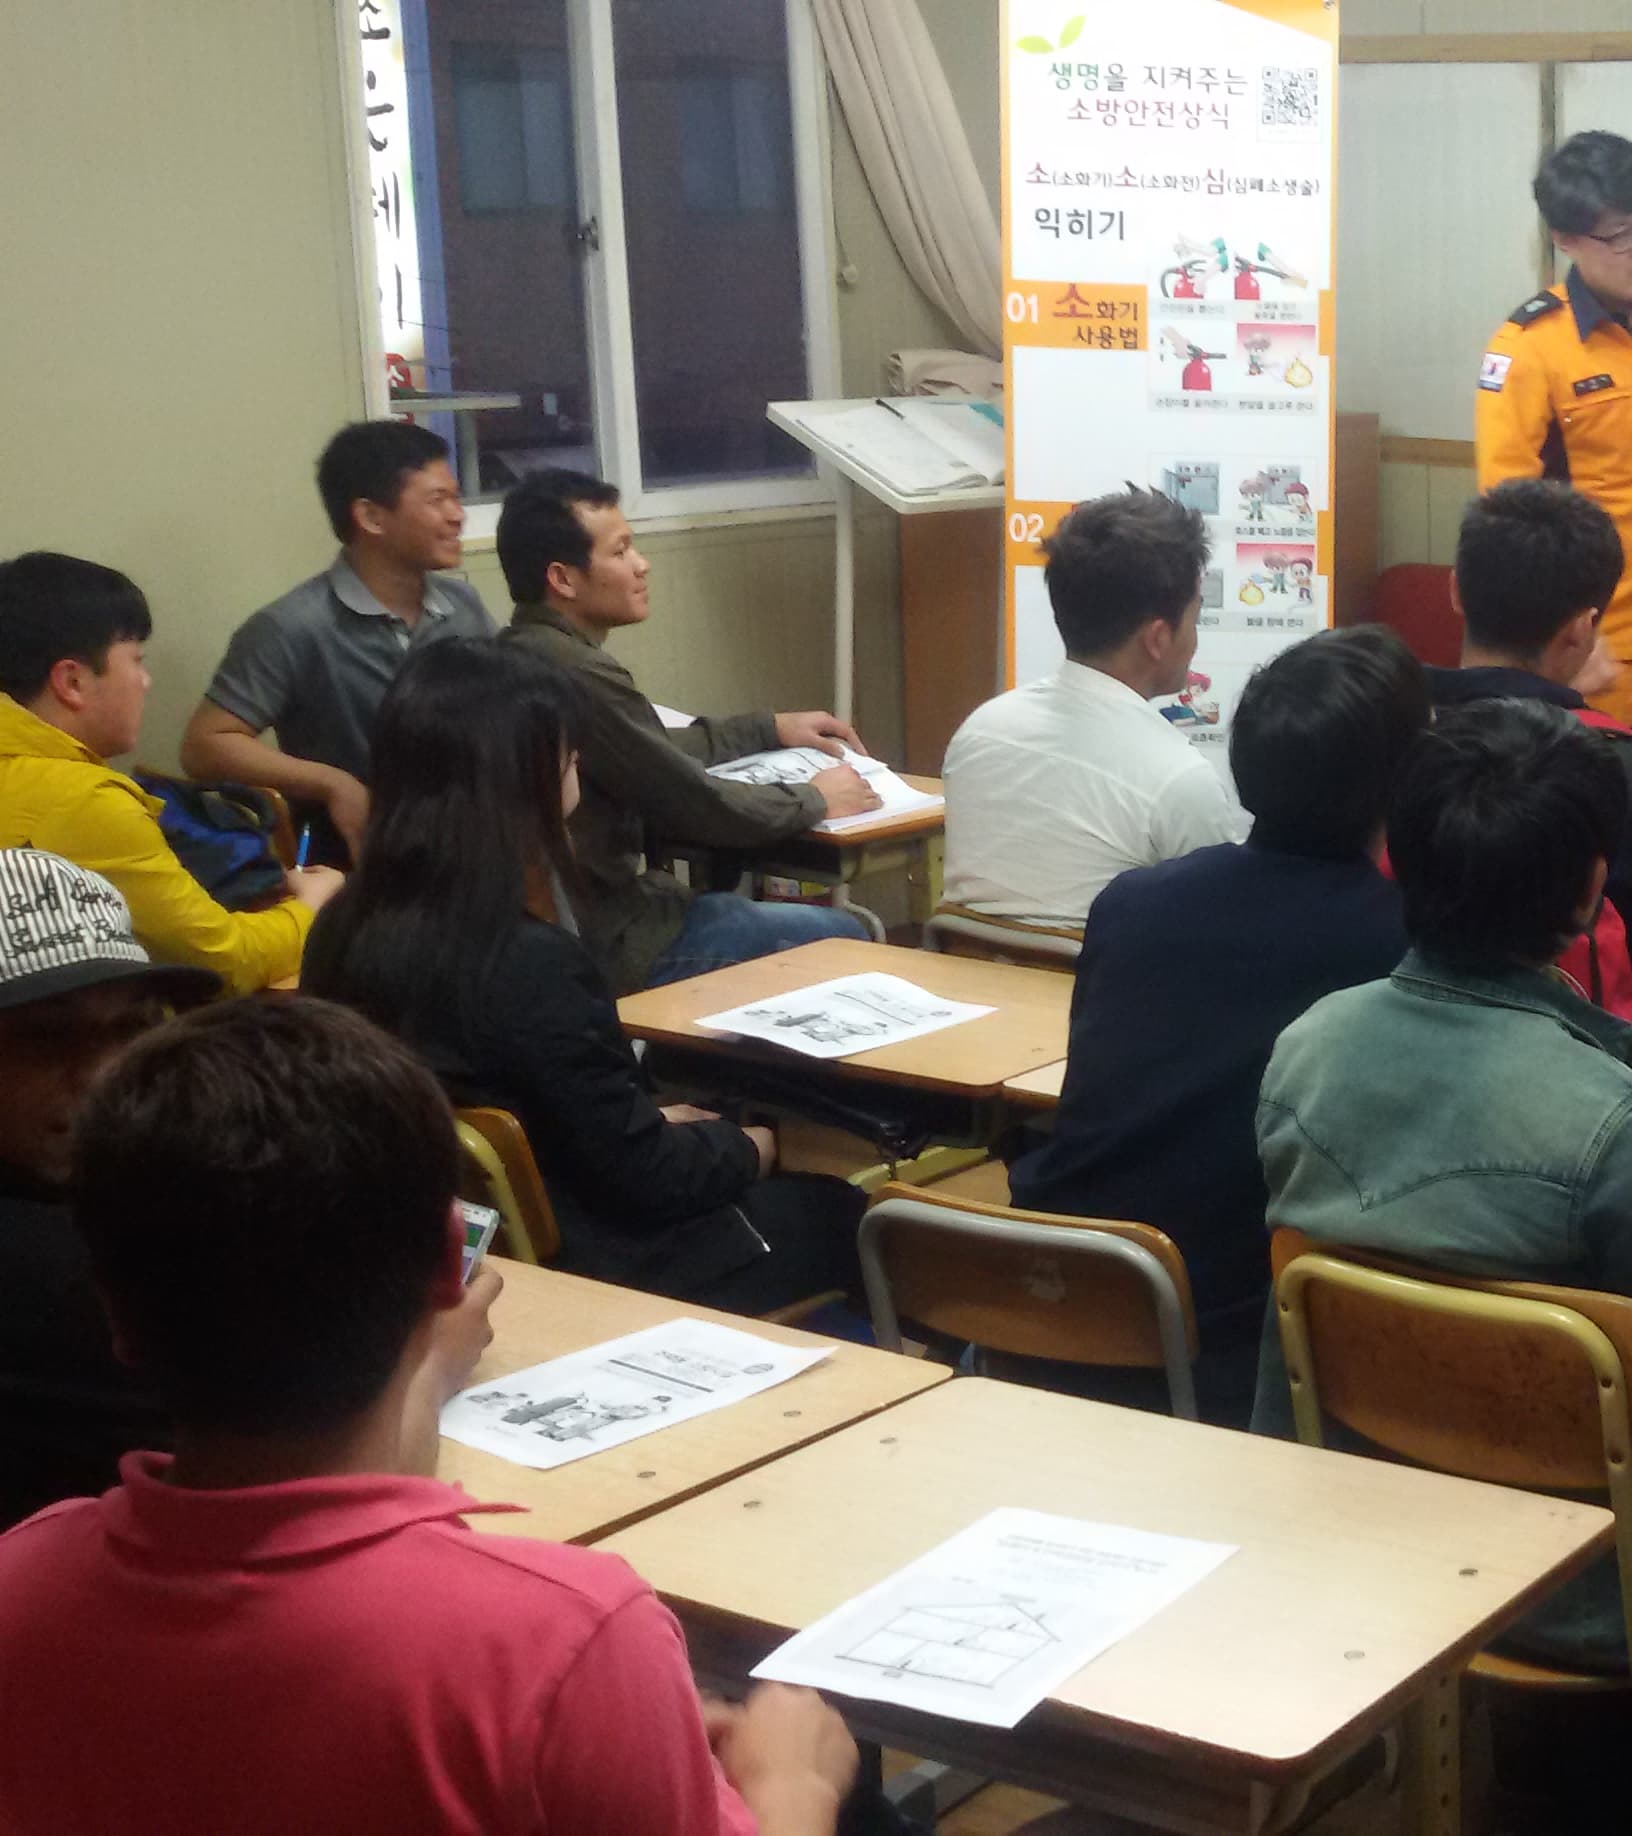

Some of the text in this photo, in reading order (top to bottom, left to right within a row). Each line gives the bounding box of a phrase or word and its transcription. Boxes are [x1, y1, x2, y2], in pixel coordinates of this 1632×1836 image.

[1050, 63, 1248, 95] 생명을 지켜주는
[1067, 98, 1229, 130] 소방안전상식
[1035, 207, 1124, 240] 익히기
[1006, 283, 1138, 324] 01 소화기
[1073, 326, 1138, 350] 사용법
[1009, 512, 1044, 544] 02
